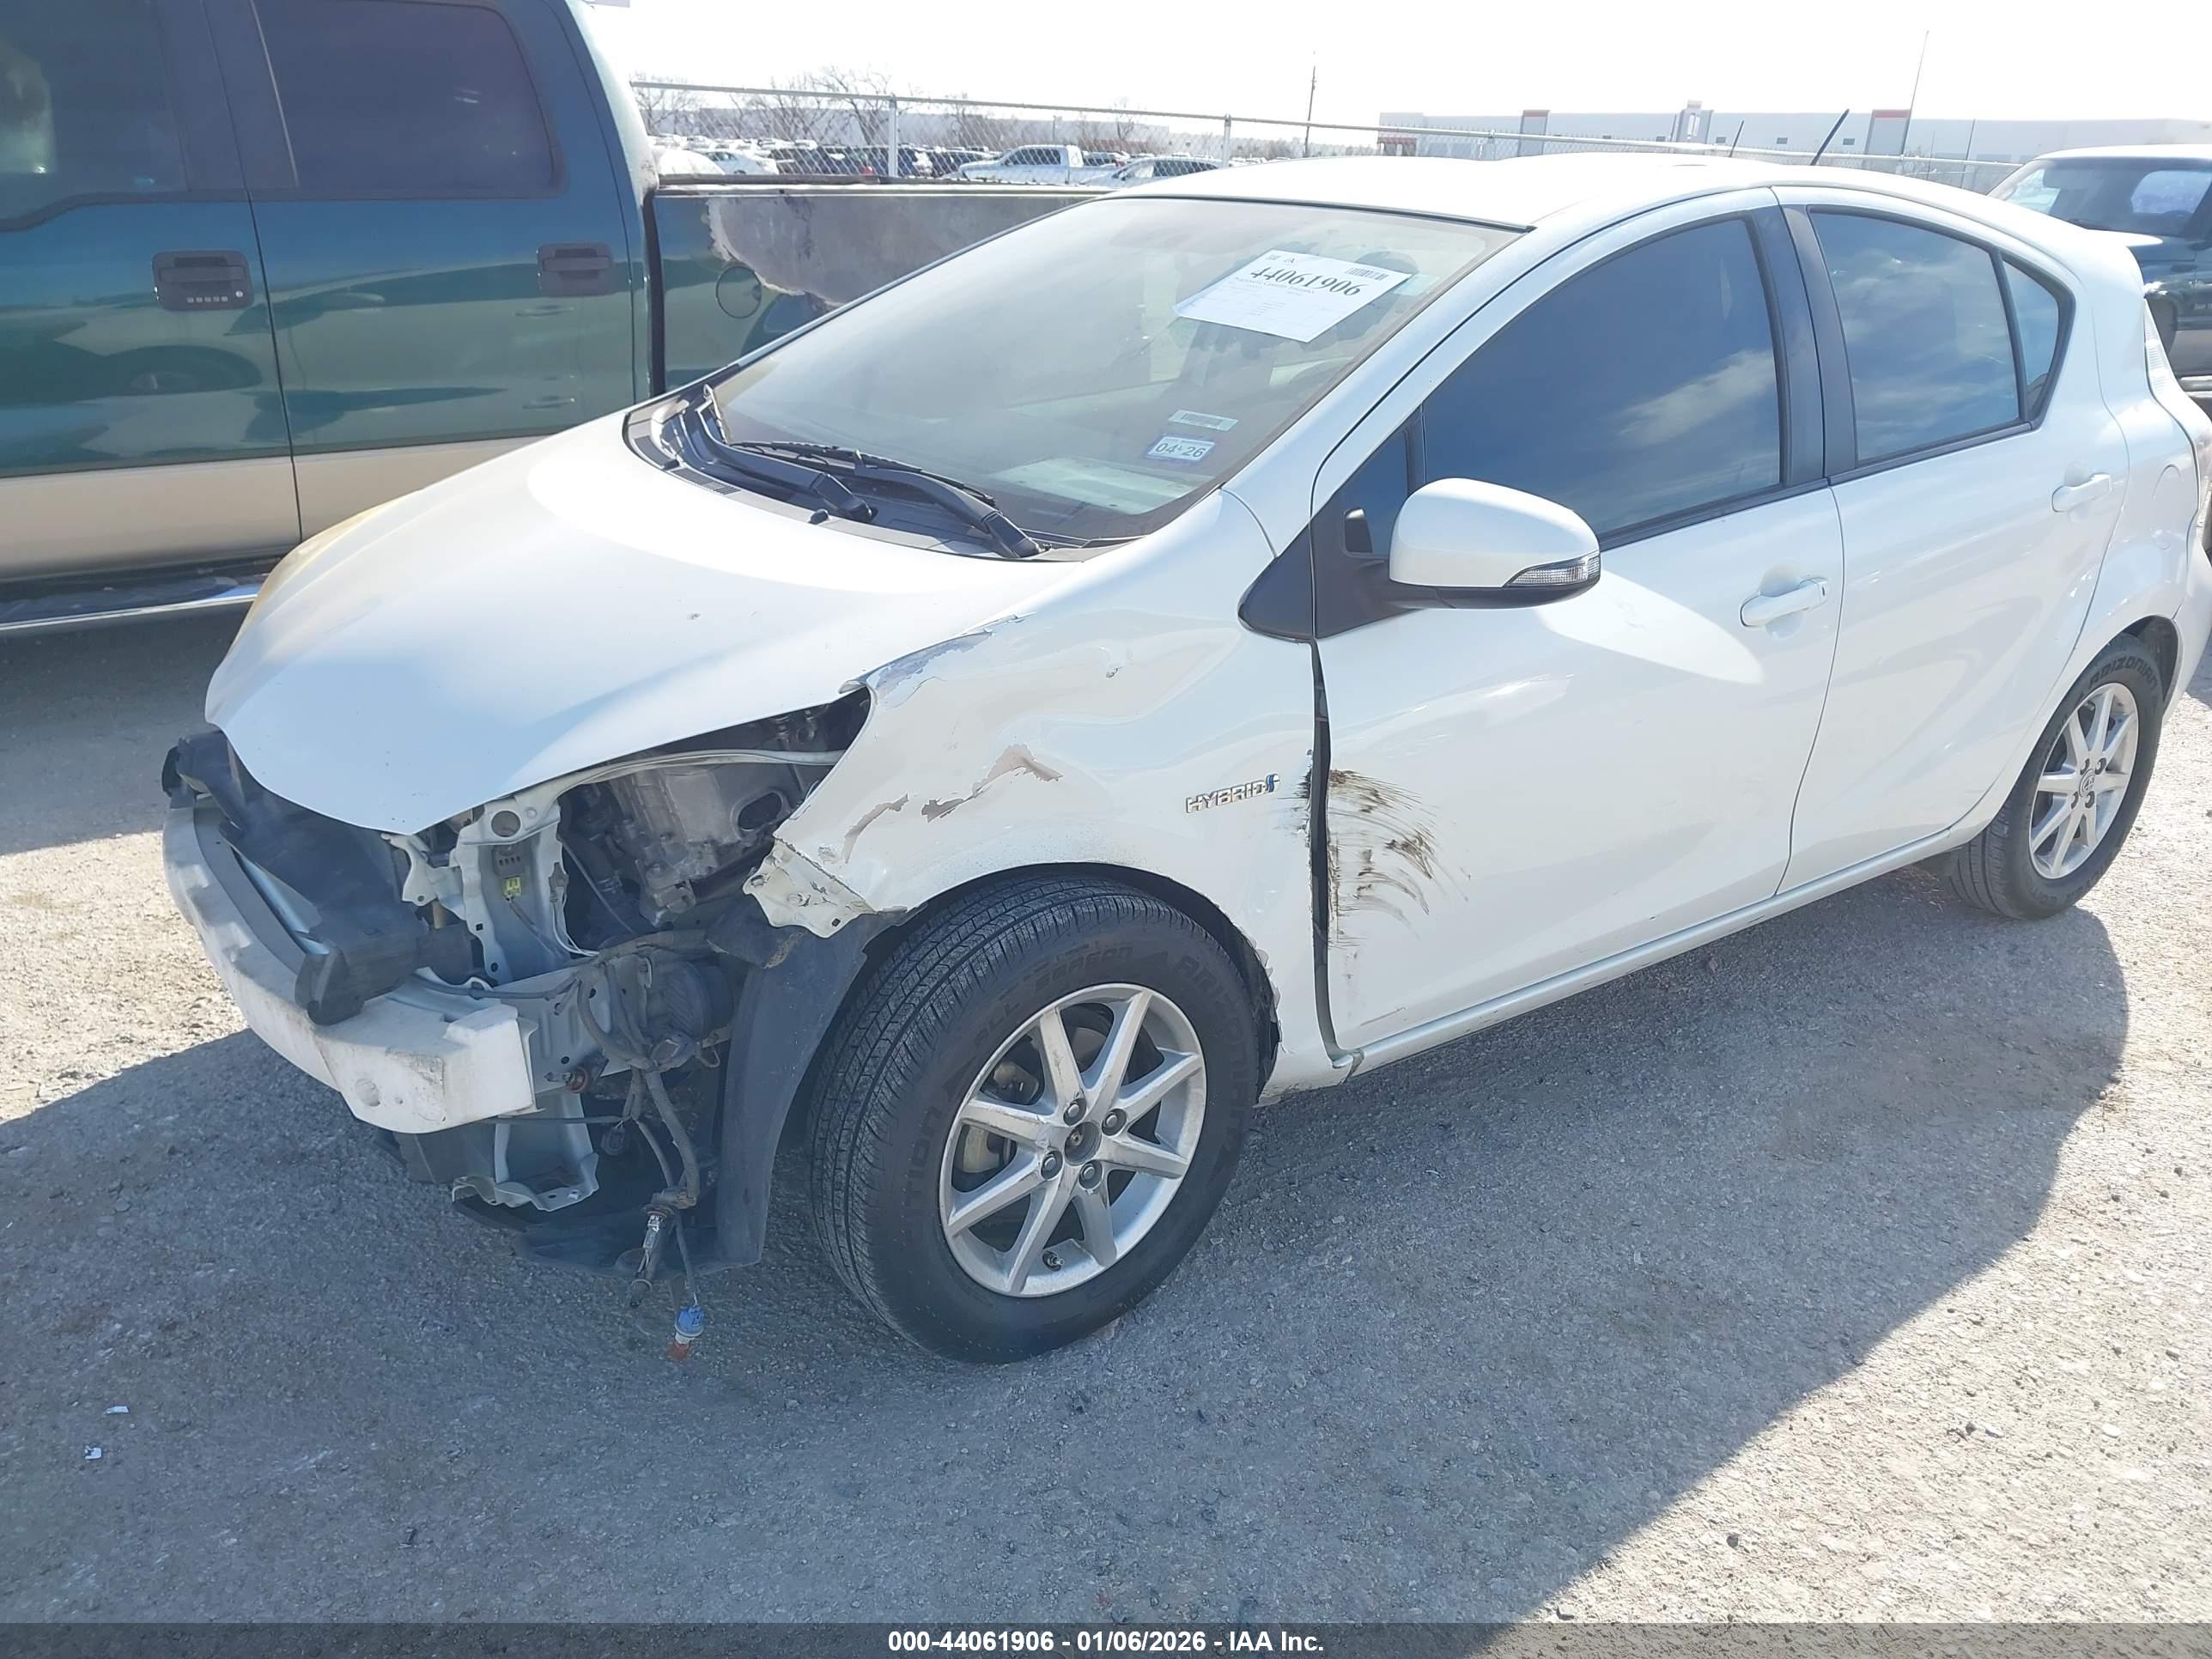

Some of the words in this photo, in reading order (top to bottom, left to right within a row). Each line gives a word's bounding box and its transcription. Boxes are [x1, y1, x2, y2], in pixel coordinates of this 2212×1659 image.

[1250, 266, 1364, 296] 44061906
[1155, 443, 1177, 454] 04
[1182, 447, 1206, 458] 26
[1186, 780, 1267, 812] HYBRID
